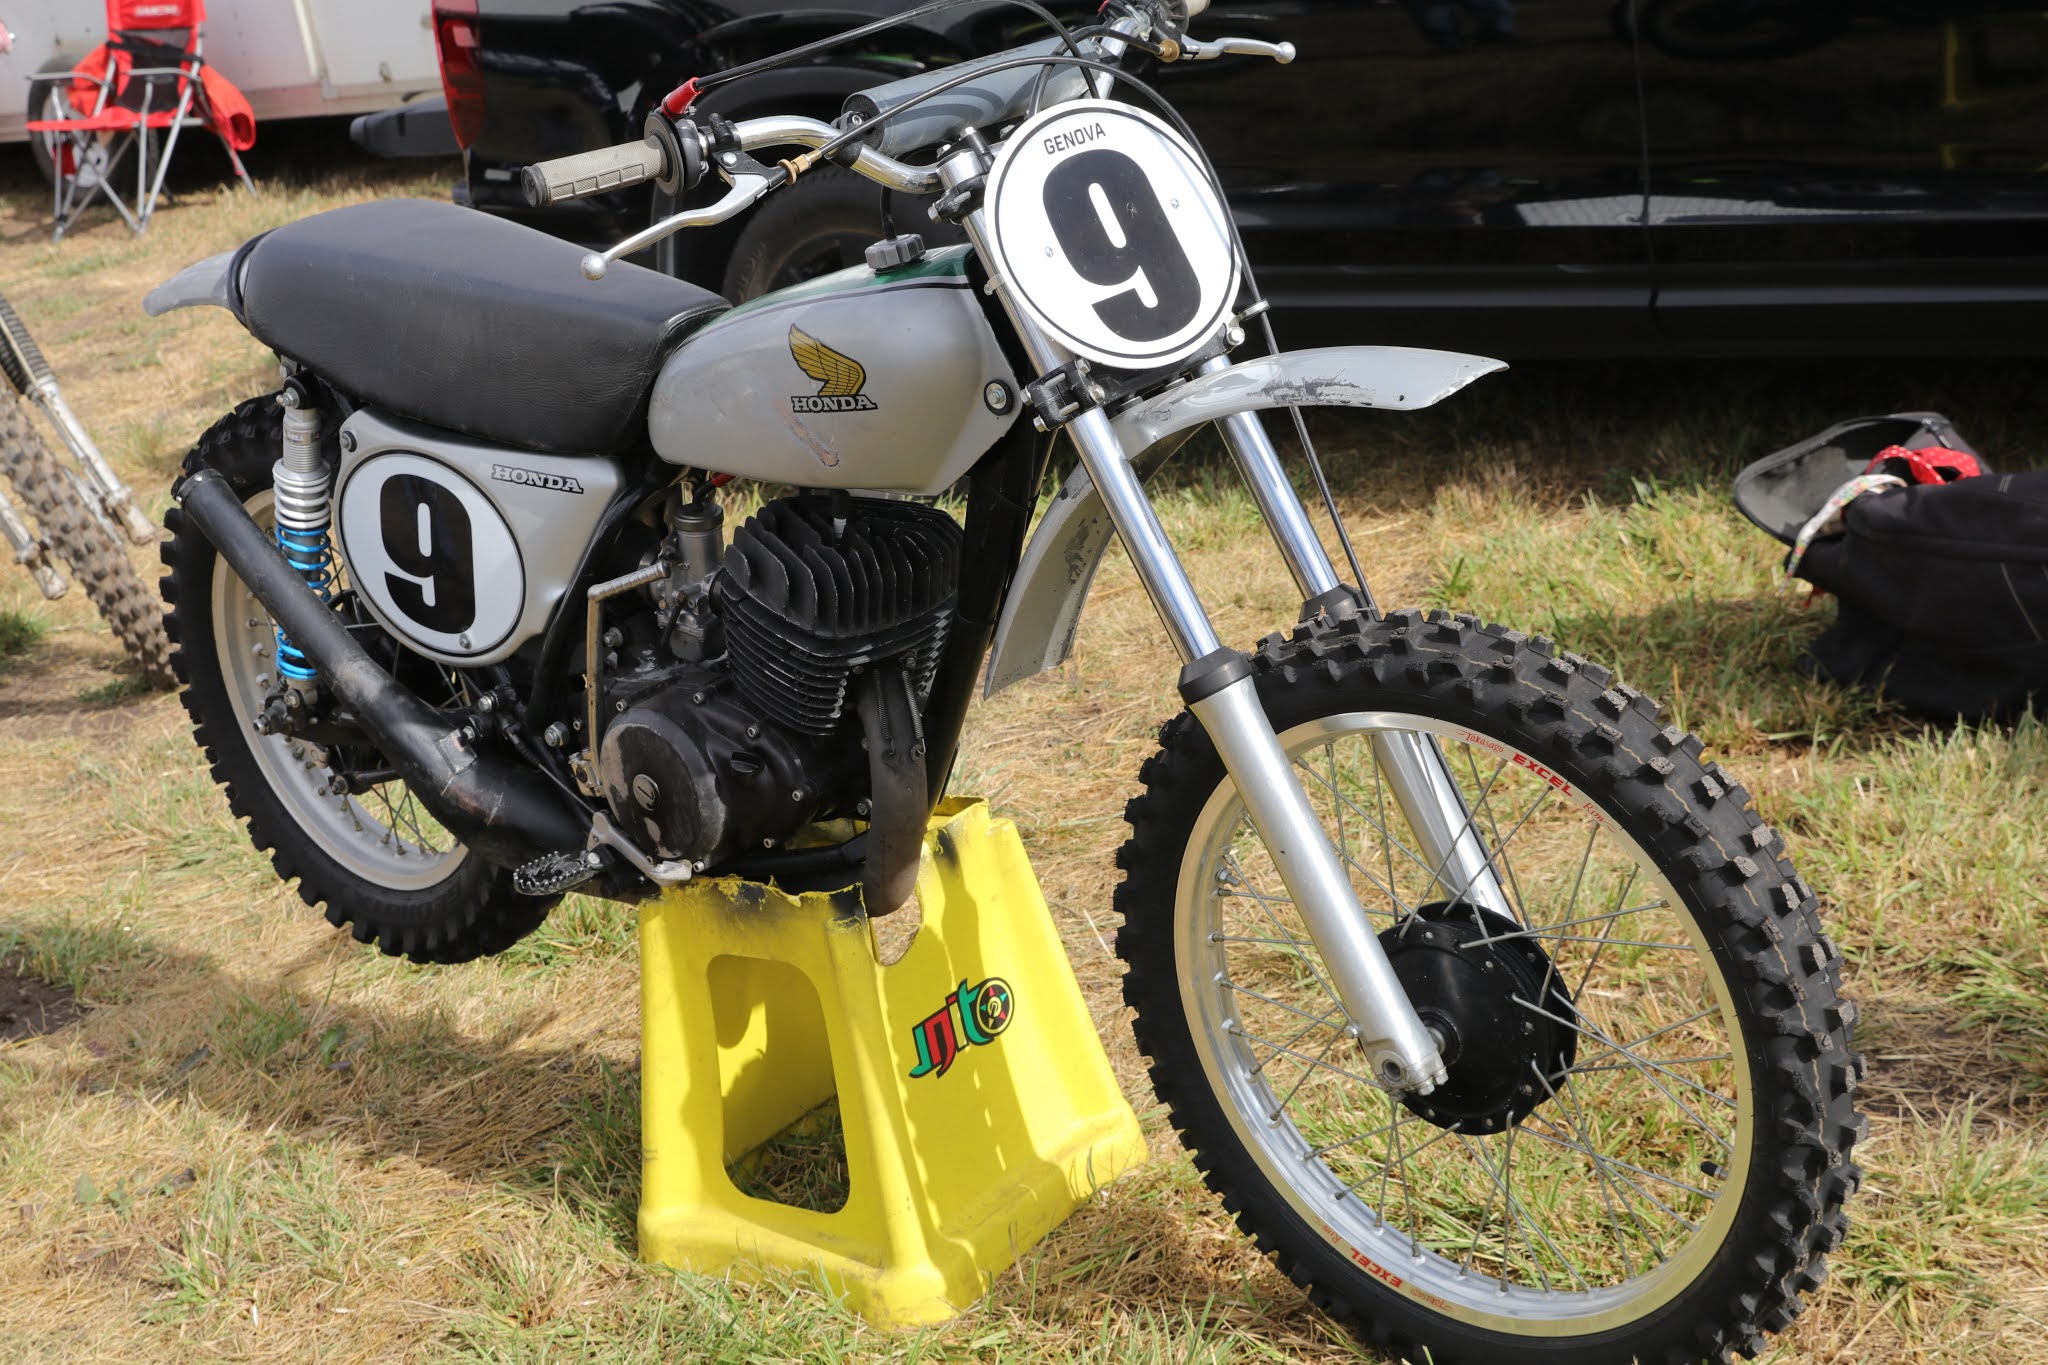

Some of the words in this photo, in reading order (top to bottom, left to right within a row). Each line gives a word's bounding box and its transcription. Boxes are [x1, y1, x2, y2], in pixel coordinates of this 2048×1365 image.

[1043, 122, 1107, 155] GENOVA
[1042, 148, 1202, 343] 9
[790, 394, 878, 413] HONDA
[491, 464, 584, 494] HONDA
[379, 473, 476, 635] 9
[1456, 728, 1504, 753] Takasago
[1512, 752, 1573, 797] EXCEL
[1350, 1247, 1404, 1289] EXCEL
